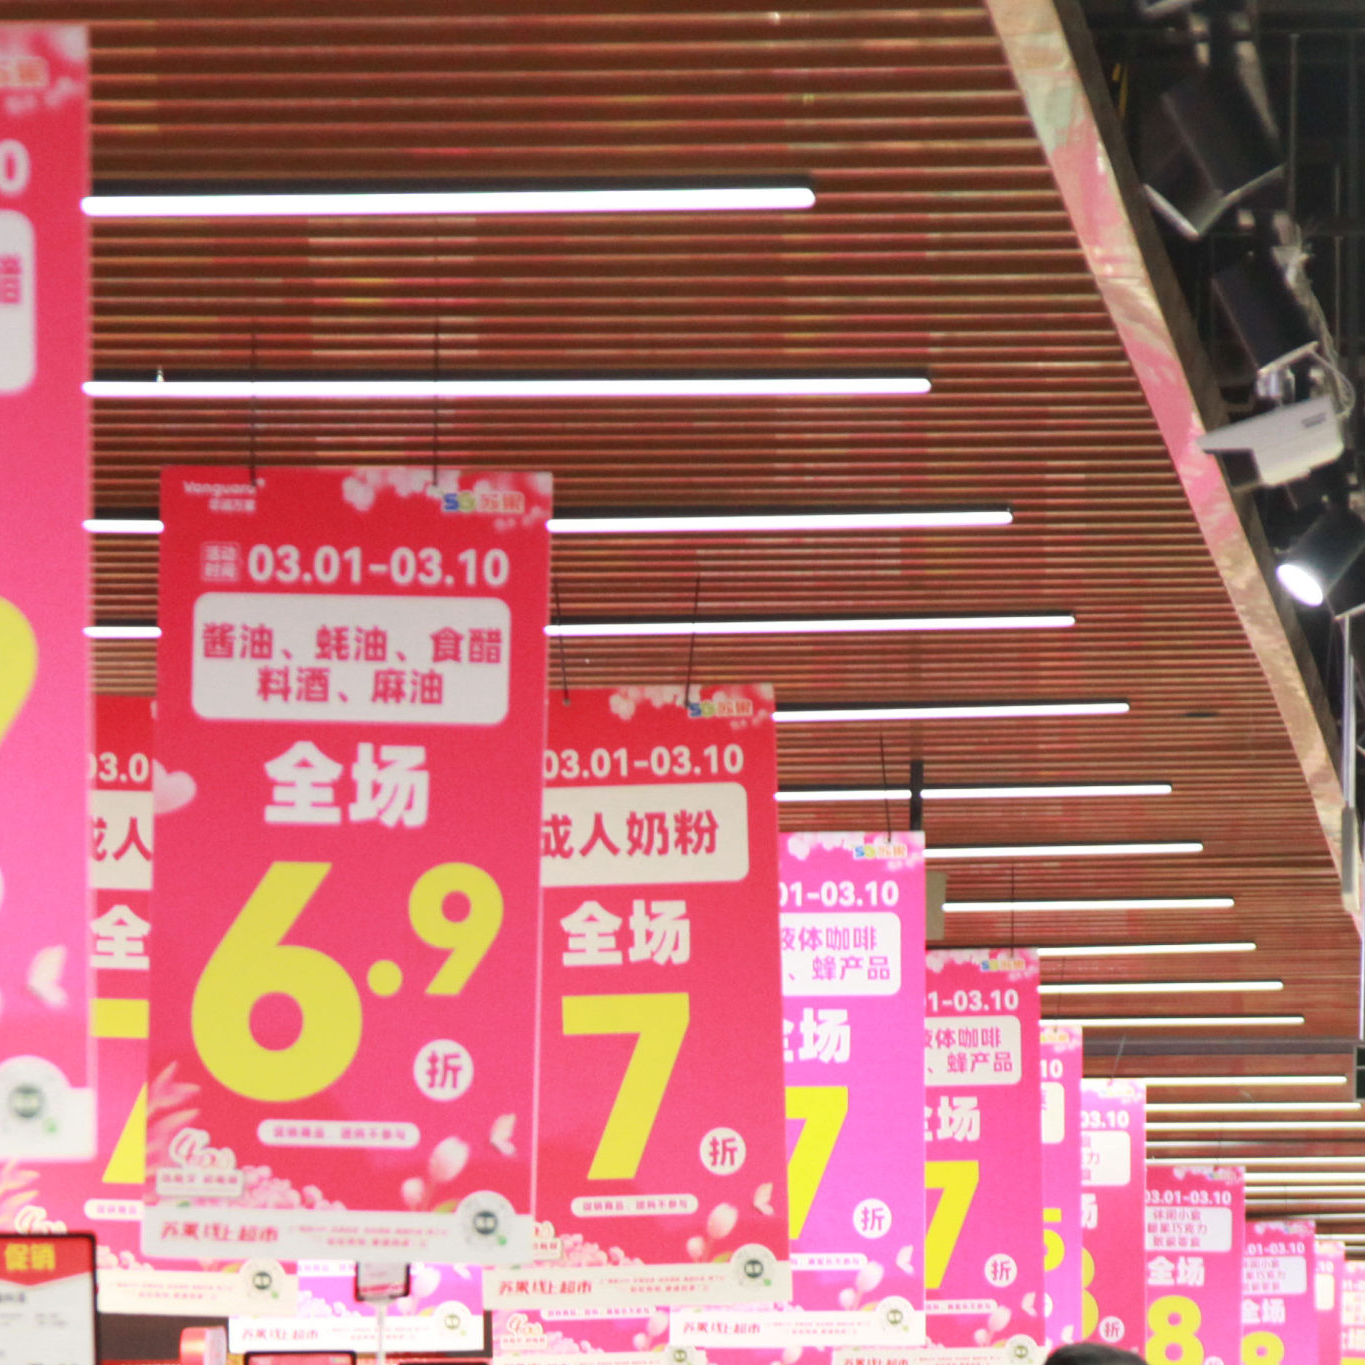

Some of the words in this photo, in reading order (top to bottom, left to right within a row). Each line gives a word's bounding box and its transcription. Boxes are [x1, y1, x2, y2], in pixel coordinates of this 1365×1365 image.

[248, 544, 510, 585] 03.01-03.10
[202, 622, 504, 665] 酱油、蚝油、食醋
[256, 665, 445, 705] 料酒、麻油
[263, 740, 430, 829] 全场
[541, 810, 719, 860] 成人奶粉
[560, 899, 691, 968] 全场
[190, 861, 504, 1102] 6.9
[425, 1052, 463, 1090] 折
[561, 992, 691, 1179] 7
[709, 1137, 739, 1168] 折
[860, 1206, 885, 1231] 折
[990, 1260, 1011, 1282] 折
[1146, 1255, 1206, 1287] 全场
[1241, 1297, 1286, 1325] 全场
